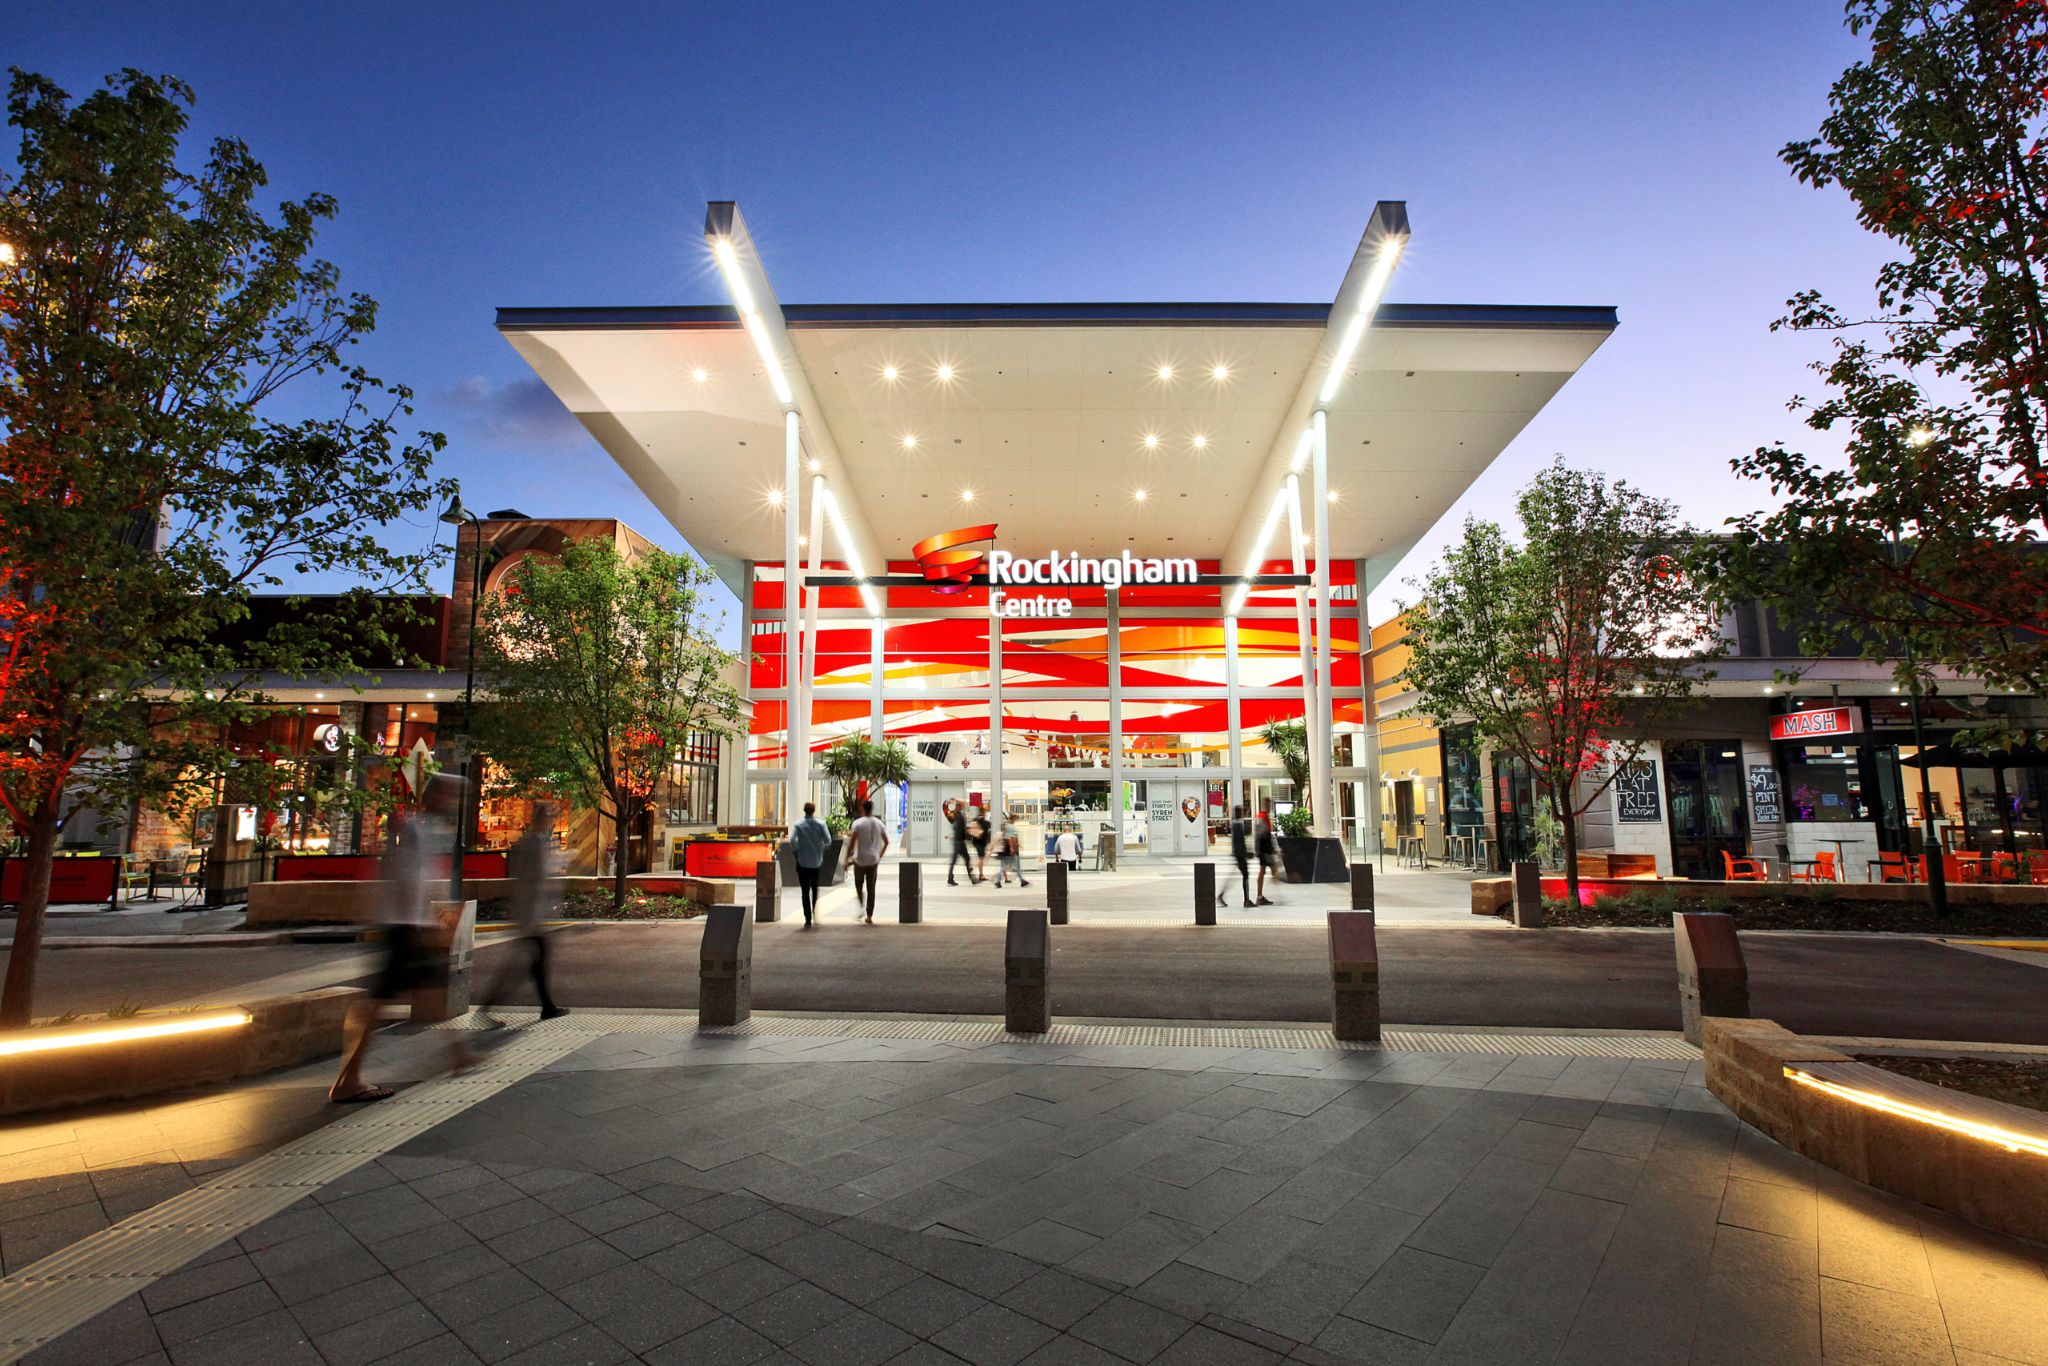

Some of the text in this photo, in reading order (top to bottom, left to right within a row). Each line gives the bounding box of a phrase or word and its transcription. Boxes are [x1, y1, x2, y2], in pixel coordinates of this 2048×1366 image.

[989, 549, 1198, 589] Rockingham
[989, 591, 1073, 617] Centre
[1783, 712, 1838, 735] MASH
[1618, 777, 1650, 791] EAT
[1750, 773, 1778, 790] $9.00
[1616, 791, 1656, 807] FREE
[1755, 791, 1777, 802] PINT
[1623, 808, 1656, 816] EVERYDAY
